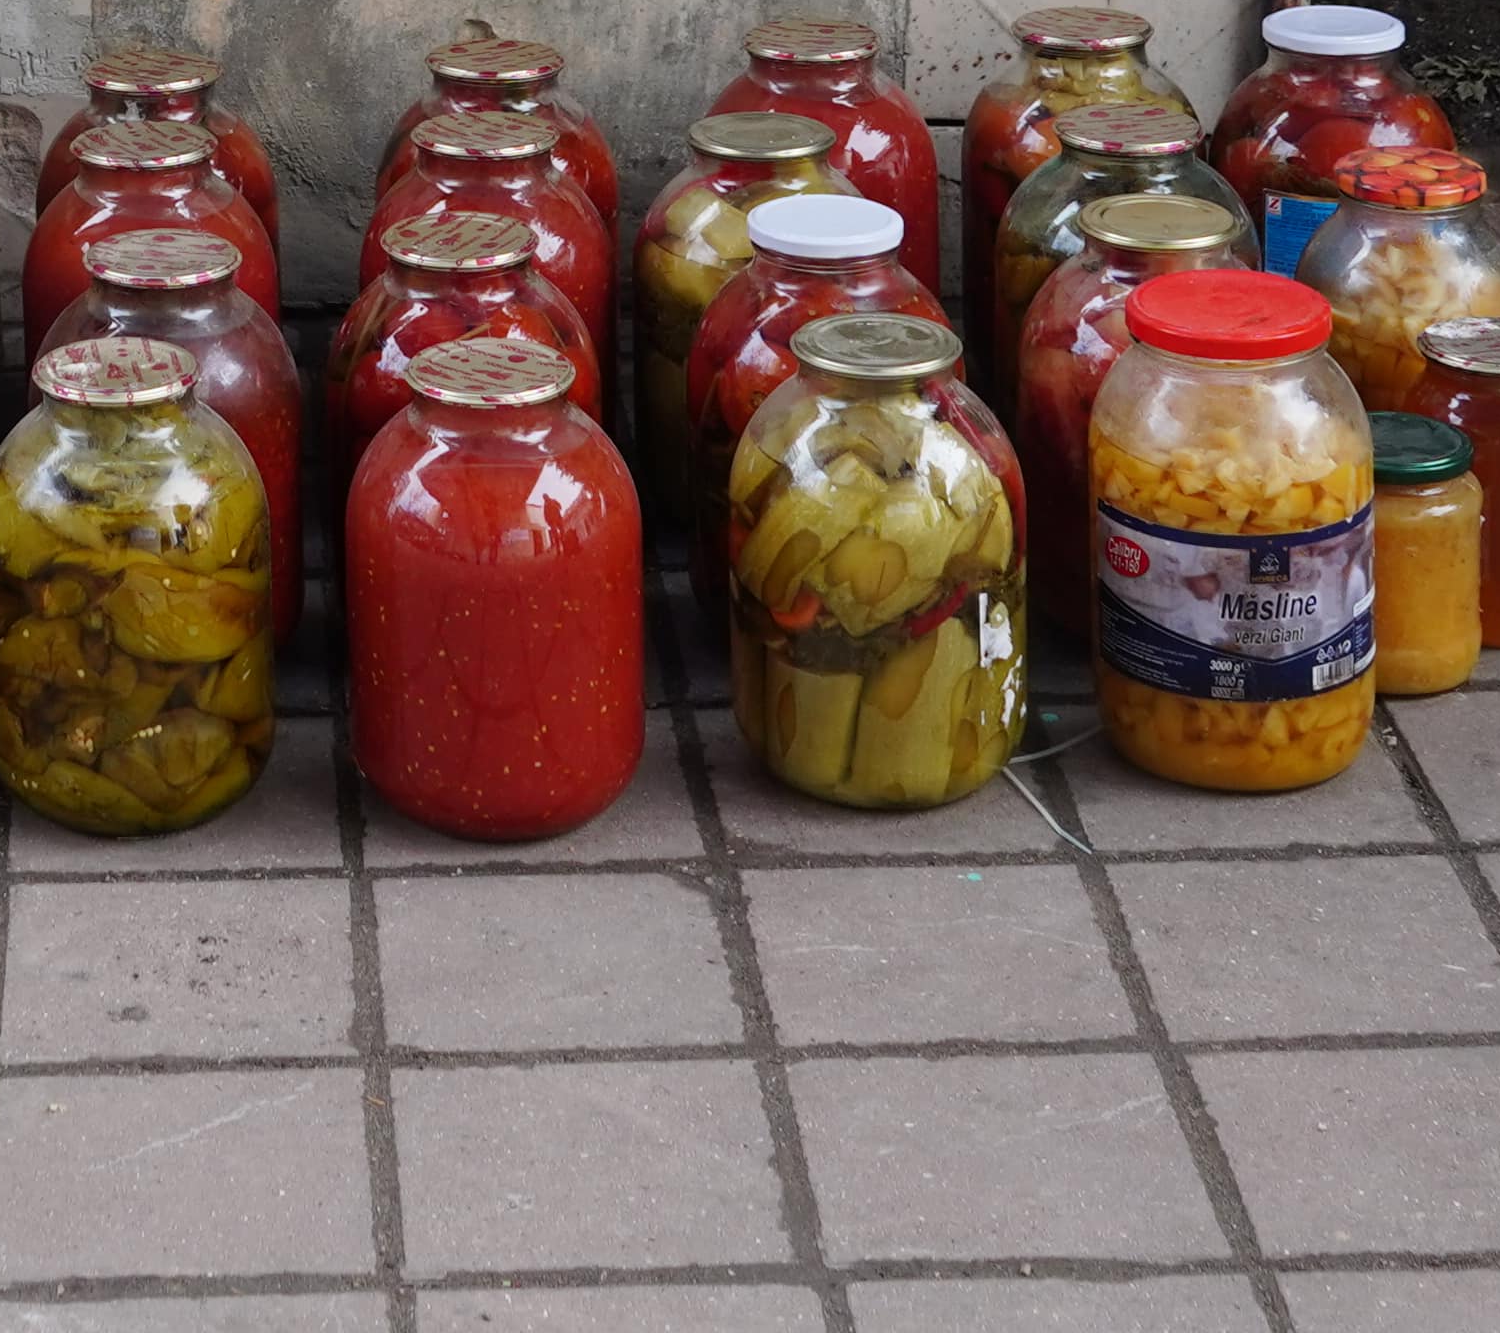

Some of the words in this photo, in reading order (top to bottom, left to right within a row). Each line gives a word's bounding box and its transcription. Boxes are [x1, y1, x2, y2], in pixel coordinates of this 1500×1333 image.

[1107, 537, 1142, 561] Calibru
[1221, 592, 1318, 620] Măsline
[1271, 626, 1304, 643] Giant
[1209, 659, 1233, 672] 3000
